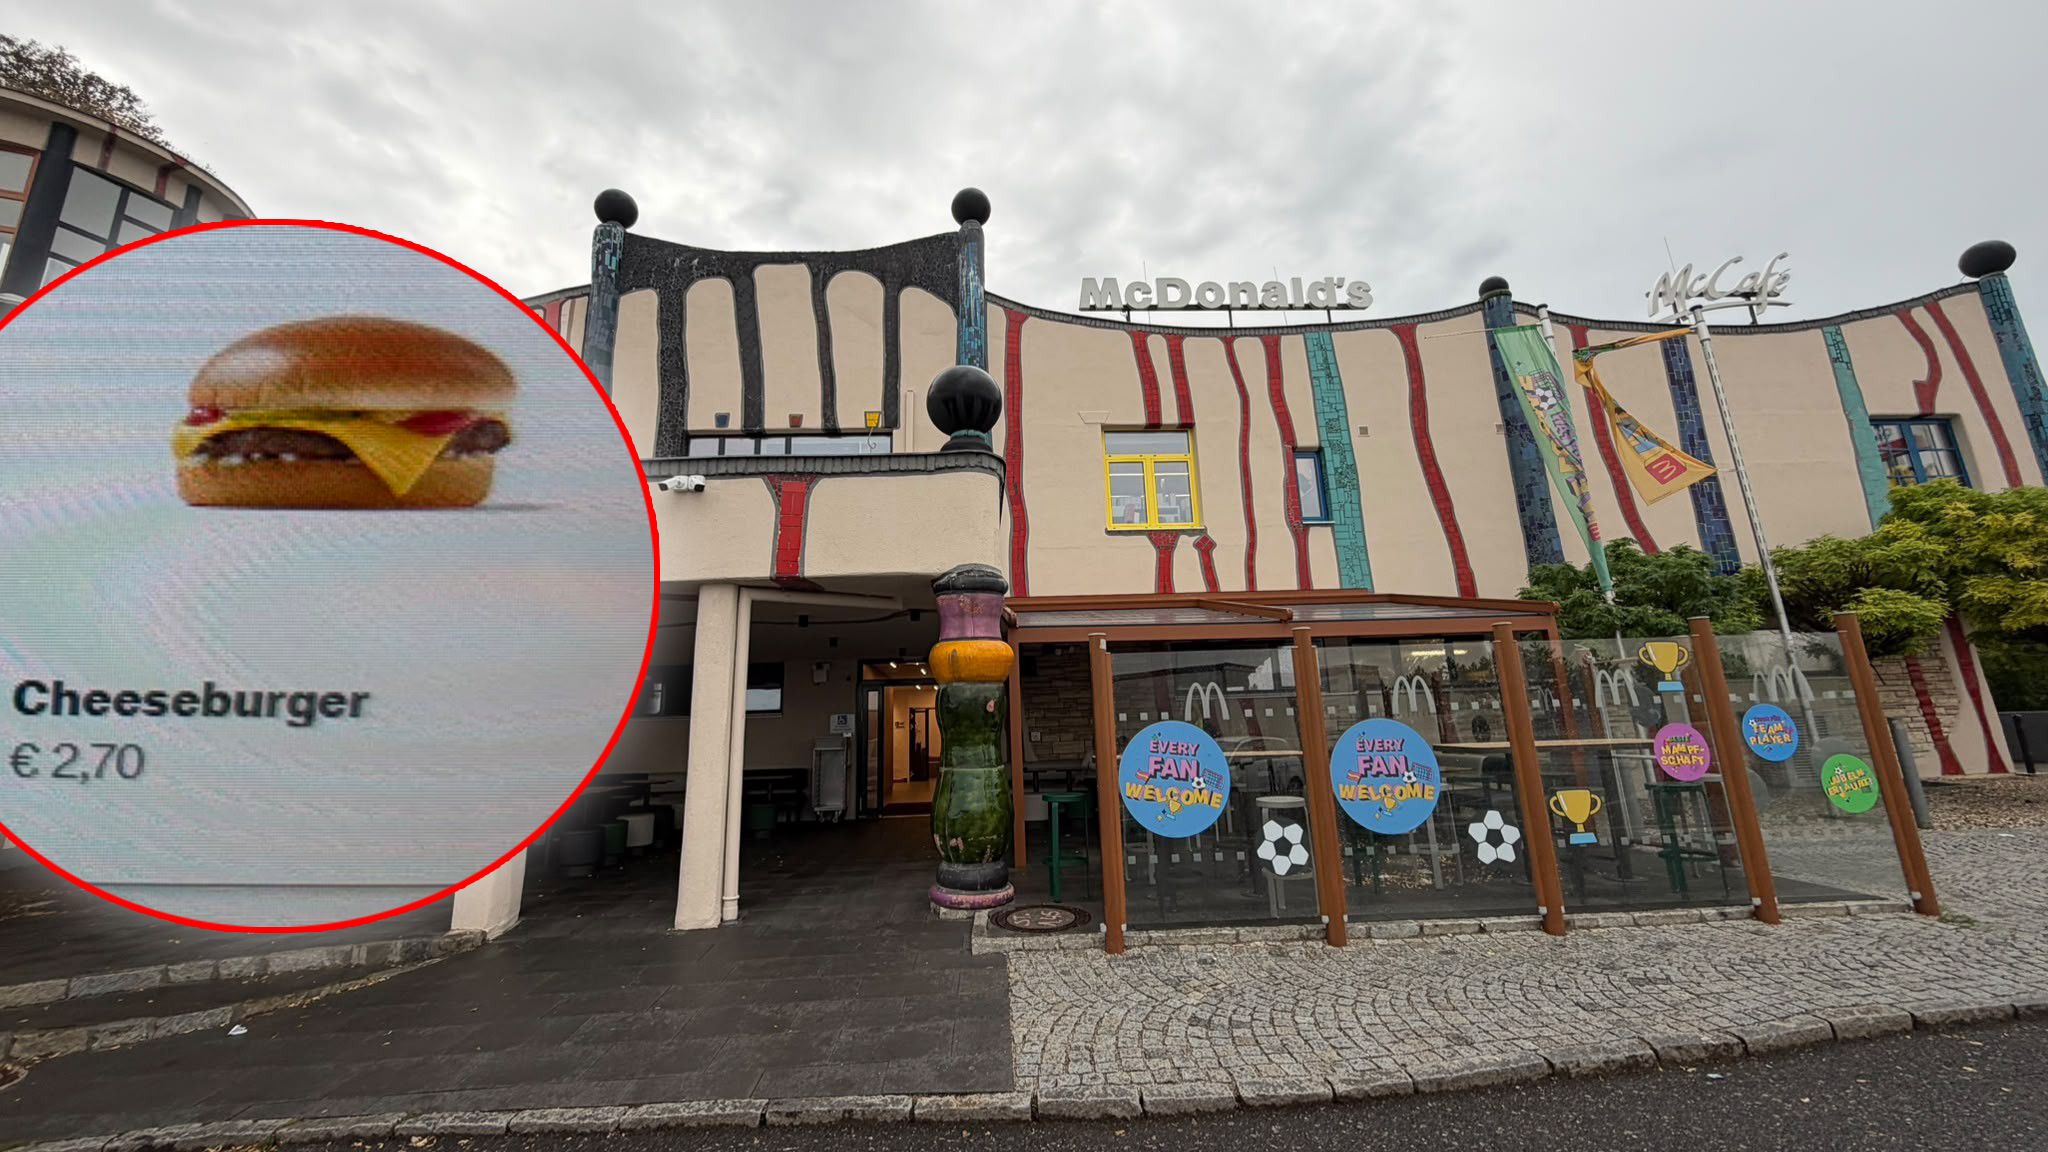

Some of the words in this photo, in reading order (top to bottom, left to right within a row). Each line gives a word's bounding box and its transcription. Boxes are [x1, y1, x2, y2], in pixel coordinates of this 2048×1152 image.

[1079, 277, 1374, 310] McDonald's
[1648, 252, 1791, 317] McCafé
[13, 679, 370, 727] Cheeseburger
[1749, 733, 1792, 746] PLAYER
[1753, 723, 1783, 735] TEAM
[1149, 740, 1199, 756] EVERY
[1356, 739, 1405, 752] EVERY
[1148, 756, 1200, 782] FAN
[1357, 755, 1409, 778] FAN
[1660, 755, 1704, 766] SCHAFT
[1126, 782, 1223, 809] WELCOME
[1339, 782, 1435, 801] WELCOME
